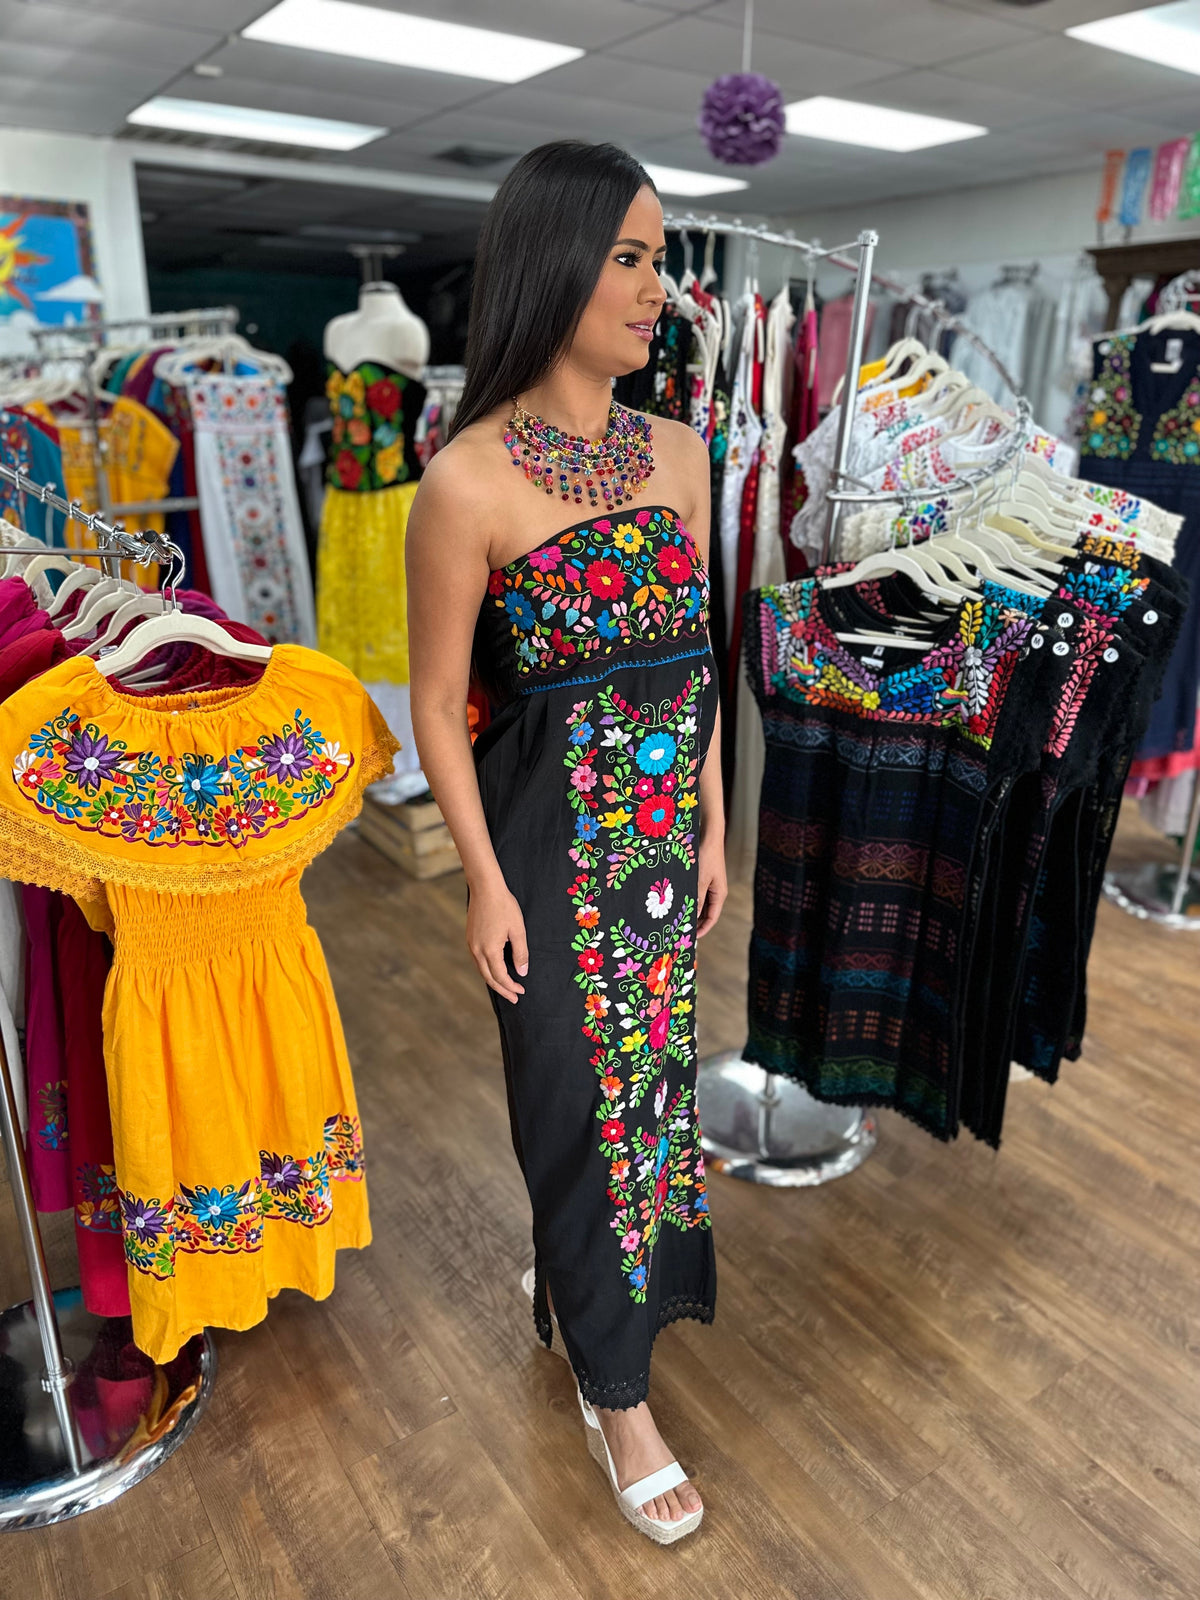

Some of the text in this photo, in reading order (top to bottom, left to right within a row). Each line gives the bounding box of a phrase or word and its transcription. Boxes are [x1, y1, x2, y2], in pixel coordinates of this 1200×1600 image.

[1060, 616, 1070, 624] M
[1033, 636, 1041, 646] M
[1056, 643, 1066, 653] M
